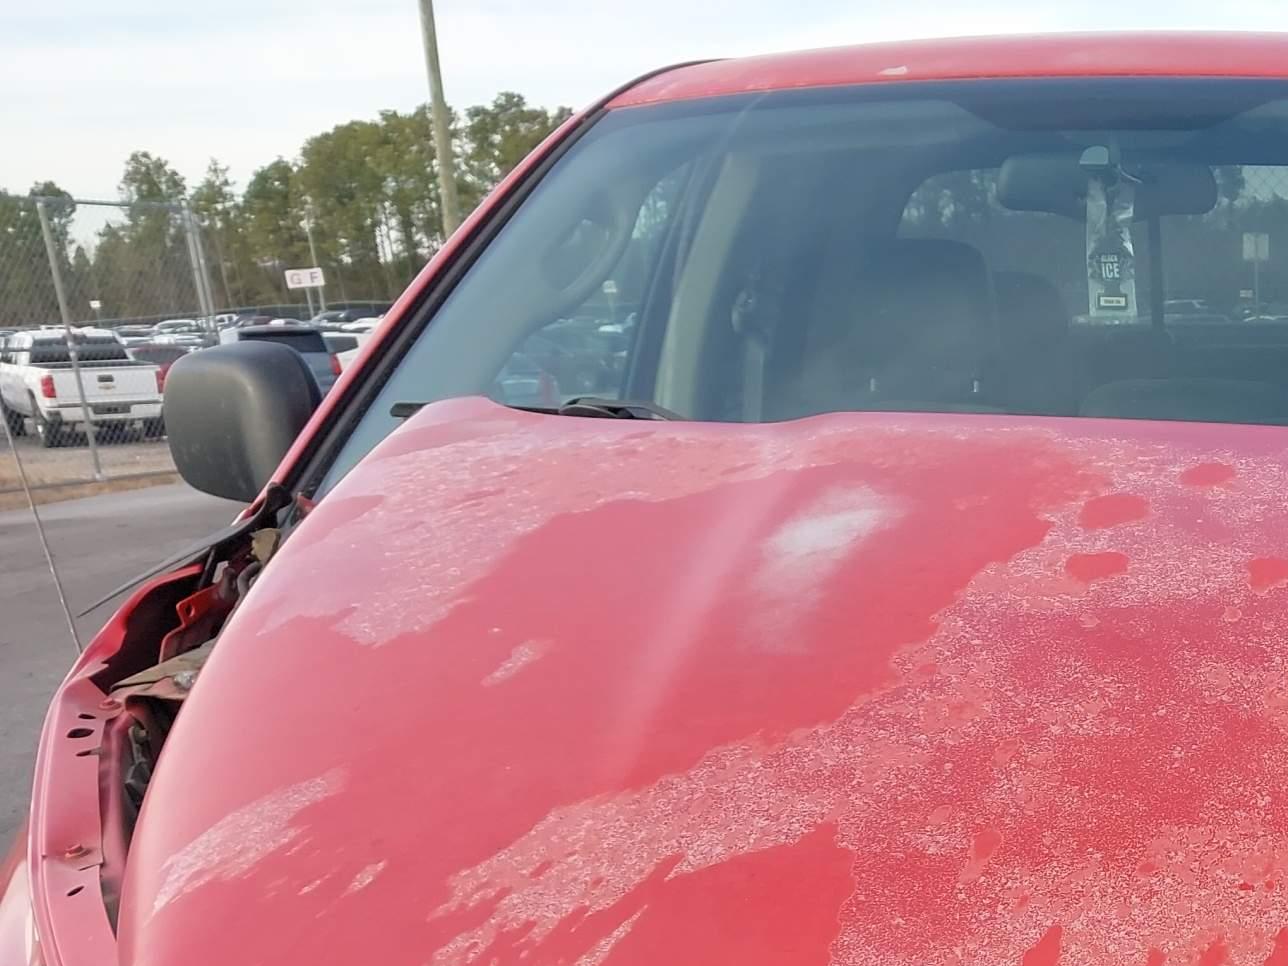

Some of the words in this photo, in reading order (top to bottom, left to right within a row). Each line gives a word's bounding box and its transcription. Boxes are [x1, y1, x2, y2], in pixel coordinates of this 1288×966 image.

[290, 273, 303, 285] G
[310, 271, 319, 284] F
[1102, 262, 1120, 279] ICE
